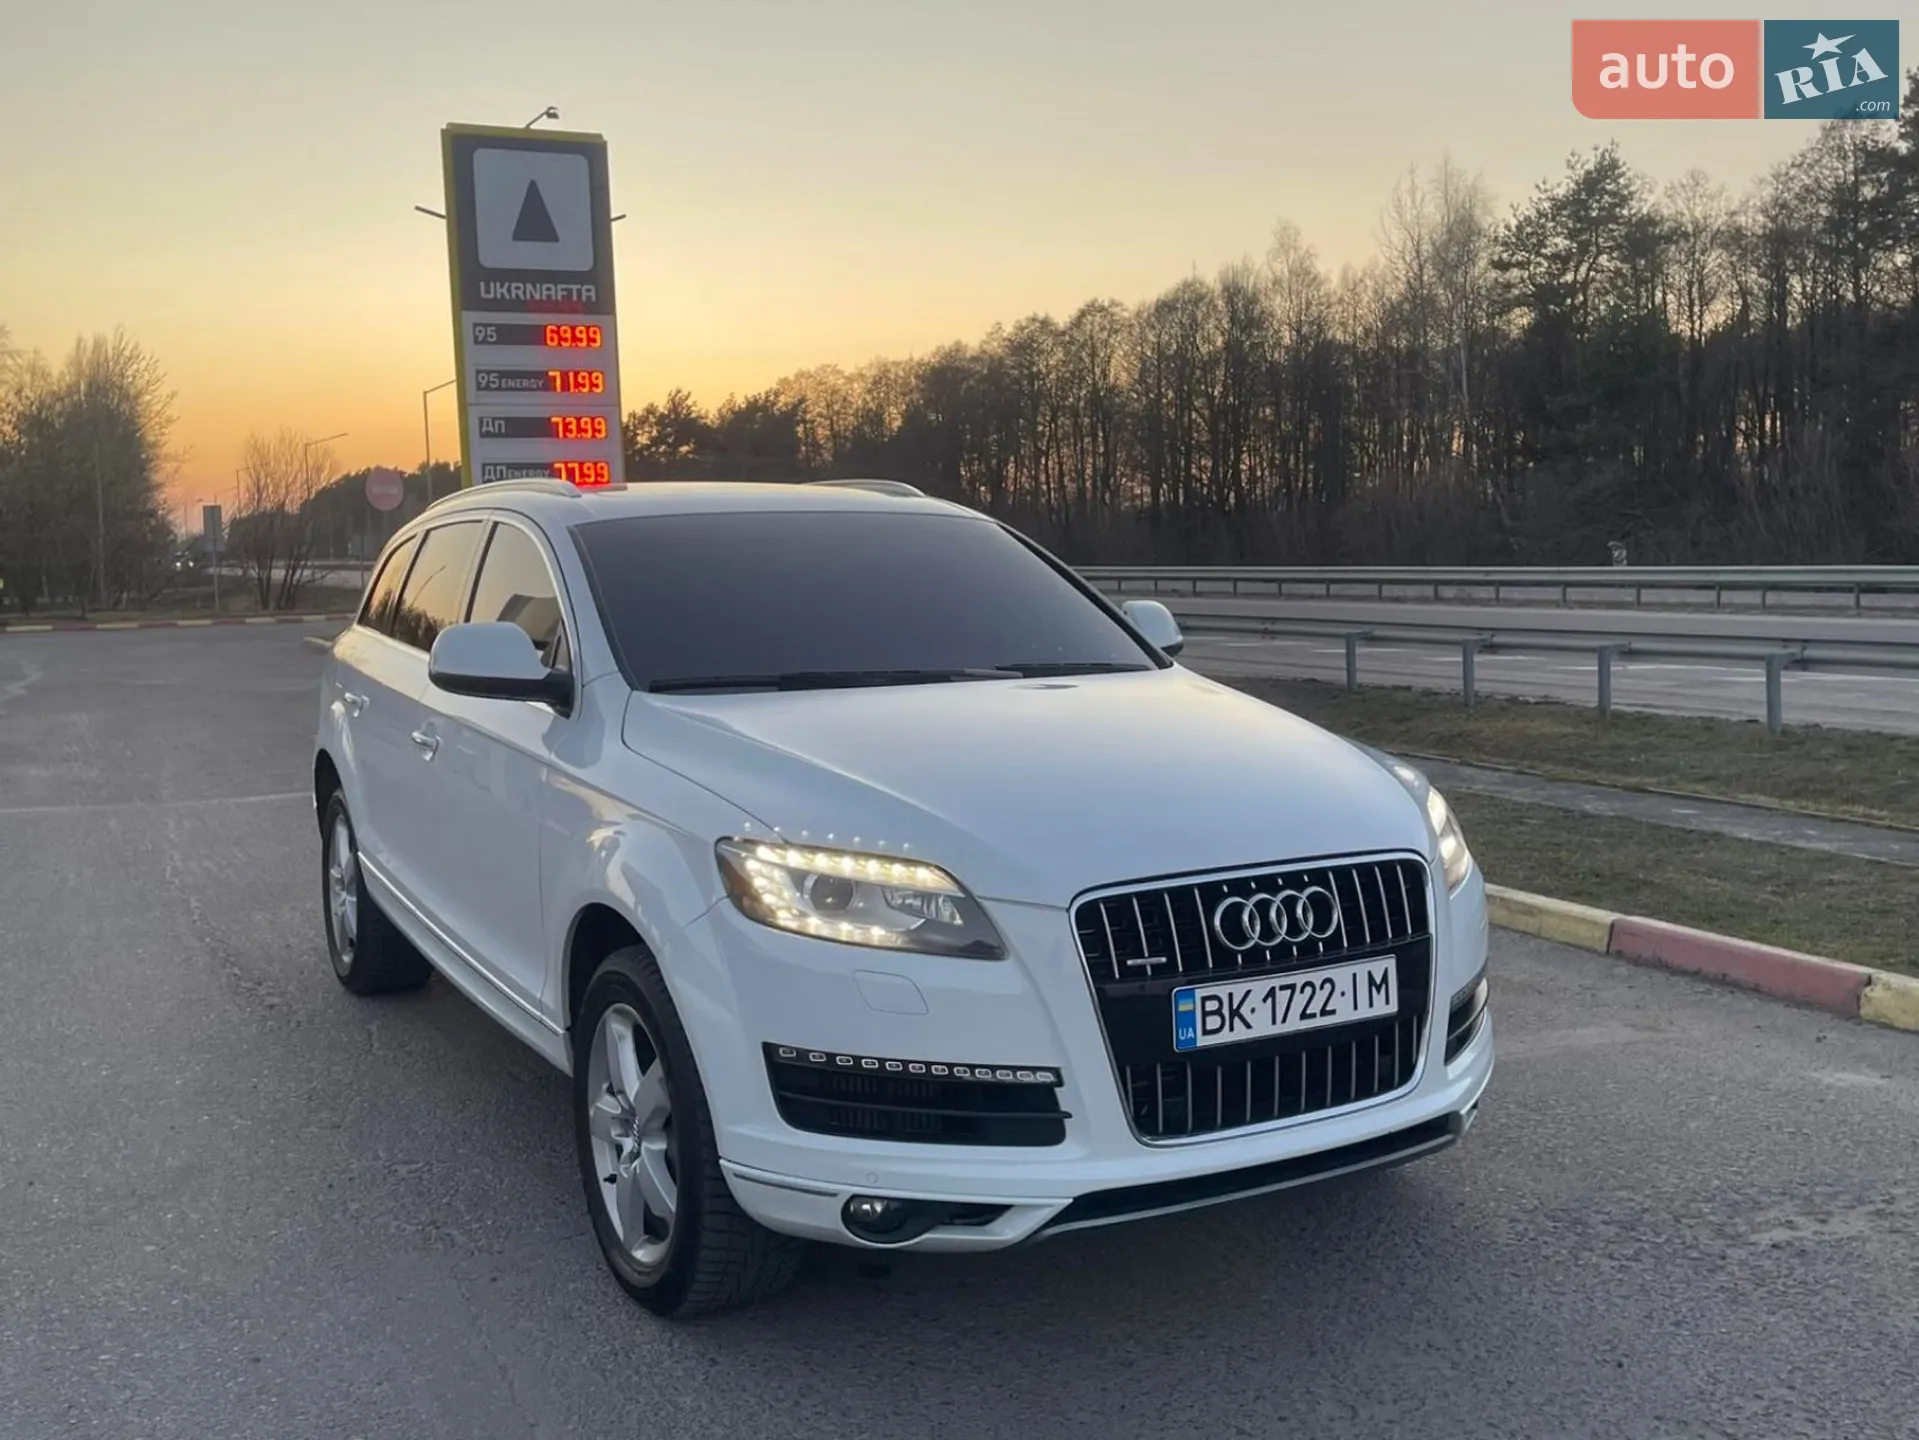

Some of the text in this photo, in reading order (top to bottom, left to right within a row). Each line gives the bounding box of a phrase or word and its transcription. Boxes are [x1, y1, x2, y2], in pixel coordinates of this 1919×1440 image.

[479, 281, 596, 302] UKRNAFTA
[474, 325, 602, 347] 95 69.99
[548, 371, 604, 393] 71.99
[551, 417, 606, 439] 73.99
[1262, 976, 1337, 1026] 1722
[1179, 1028, 1195, 1040] UA
